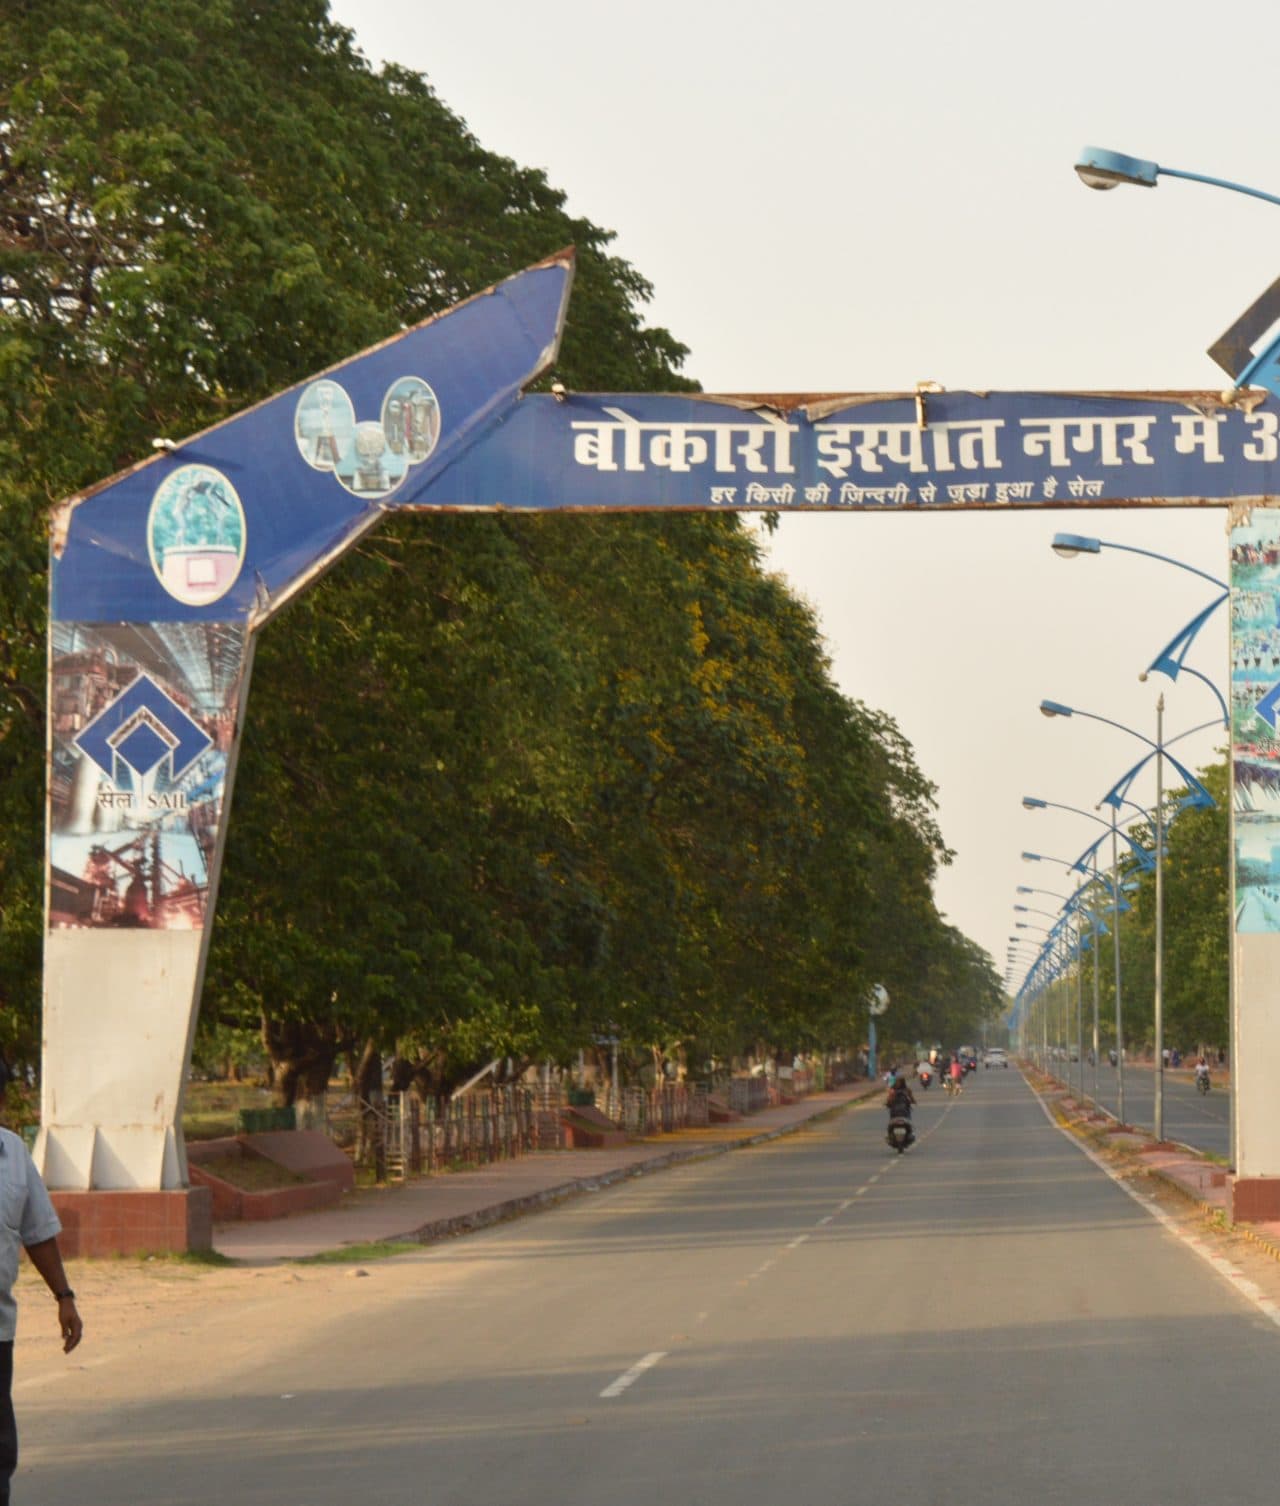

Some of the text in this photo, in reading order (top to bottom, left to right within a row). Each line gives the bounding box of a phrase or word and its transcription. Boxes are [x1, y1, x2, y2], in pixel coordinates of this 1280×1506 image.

[571, 408, 799, 473] बोकारो
[815, 419, 1005, 478] इस्पात
[1020, 416, 1157, 467] नगर
[1172, 404, 1227, 463] मे
[711, 486, 737, 503] हर
[746, 482, 796, 504] किसी
[804, 482, 831, 504] की
[918, 481, 938, 504] से
[996, 481, 1034, 504] हुआ
[1043, 475, 1058, 498] है
[1068, 475, 1104, 497] सेल
[97, 785, 133, 809] सेल
[147, 792, 189, 809] SAIL
